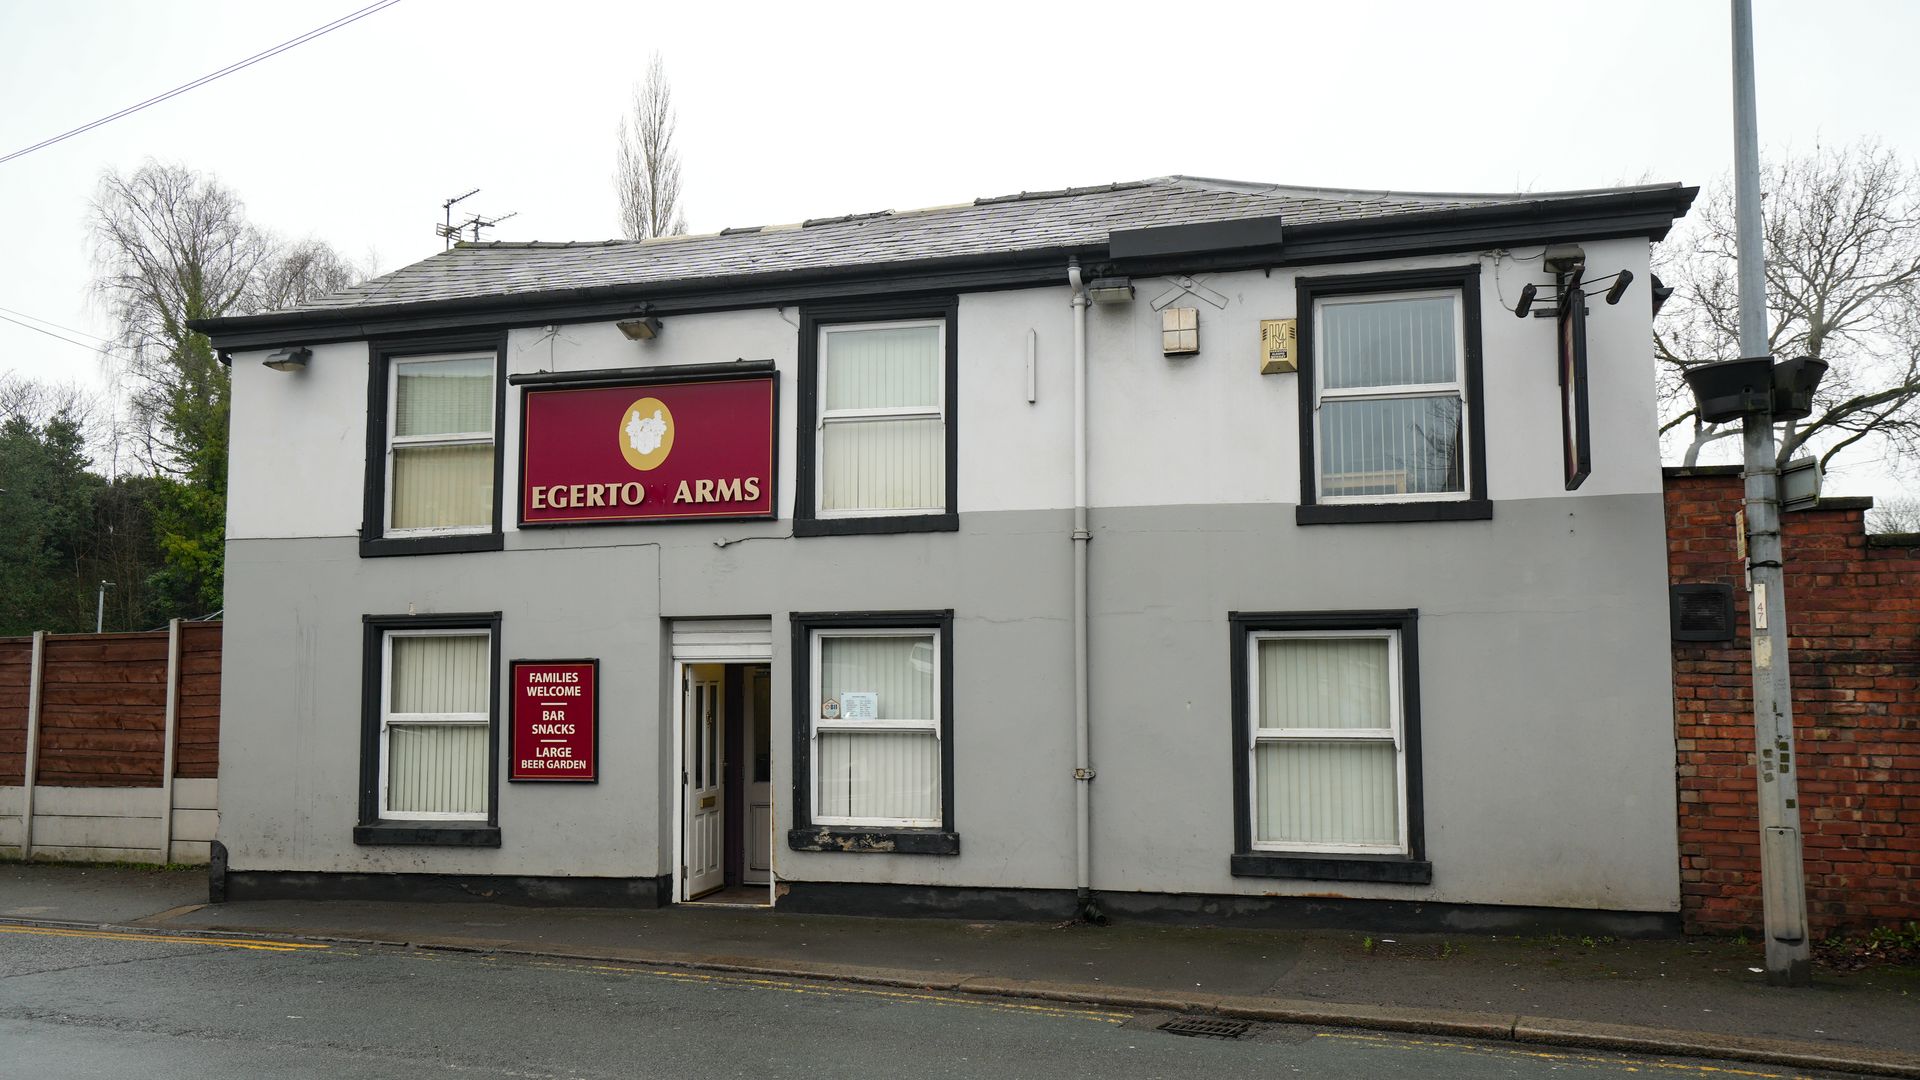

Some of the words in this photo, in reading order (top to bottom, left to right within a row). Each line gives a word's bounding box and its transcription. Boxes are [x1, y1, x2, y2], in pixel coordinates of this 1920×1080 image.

[531, 481, 645, 509] EGERTO
[672, 477, 760, 504] ARMS
[529, 672, 579, 683] FAMILIES
[526, 686, 581, 697] WELCOME
[542, 710, 565, 721] BAR
[532, 724, 576, 735] SNACKS
[536, 747, 572, 758] LARGE
[521, 760, 545, 769] BEER
[546, 760, 587, 769] GARDEN
